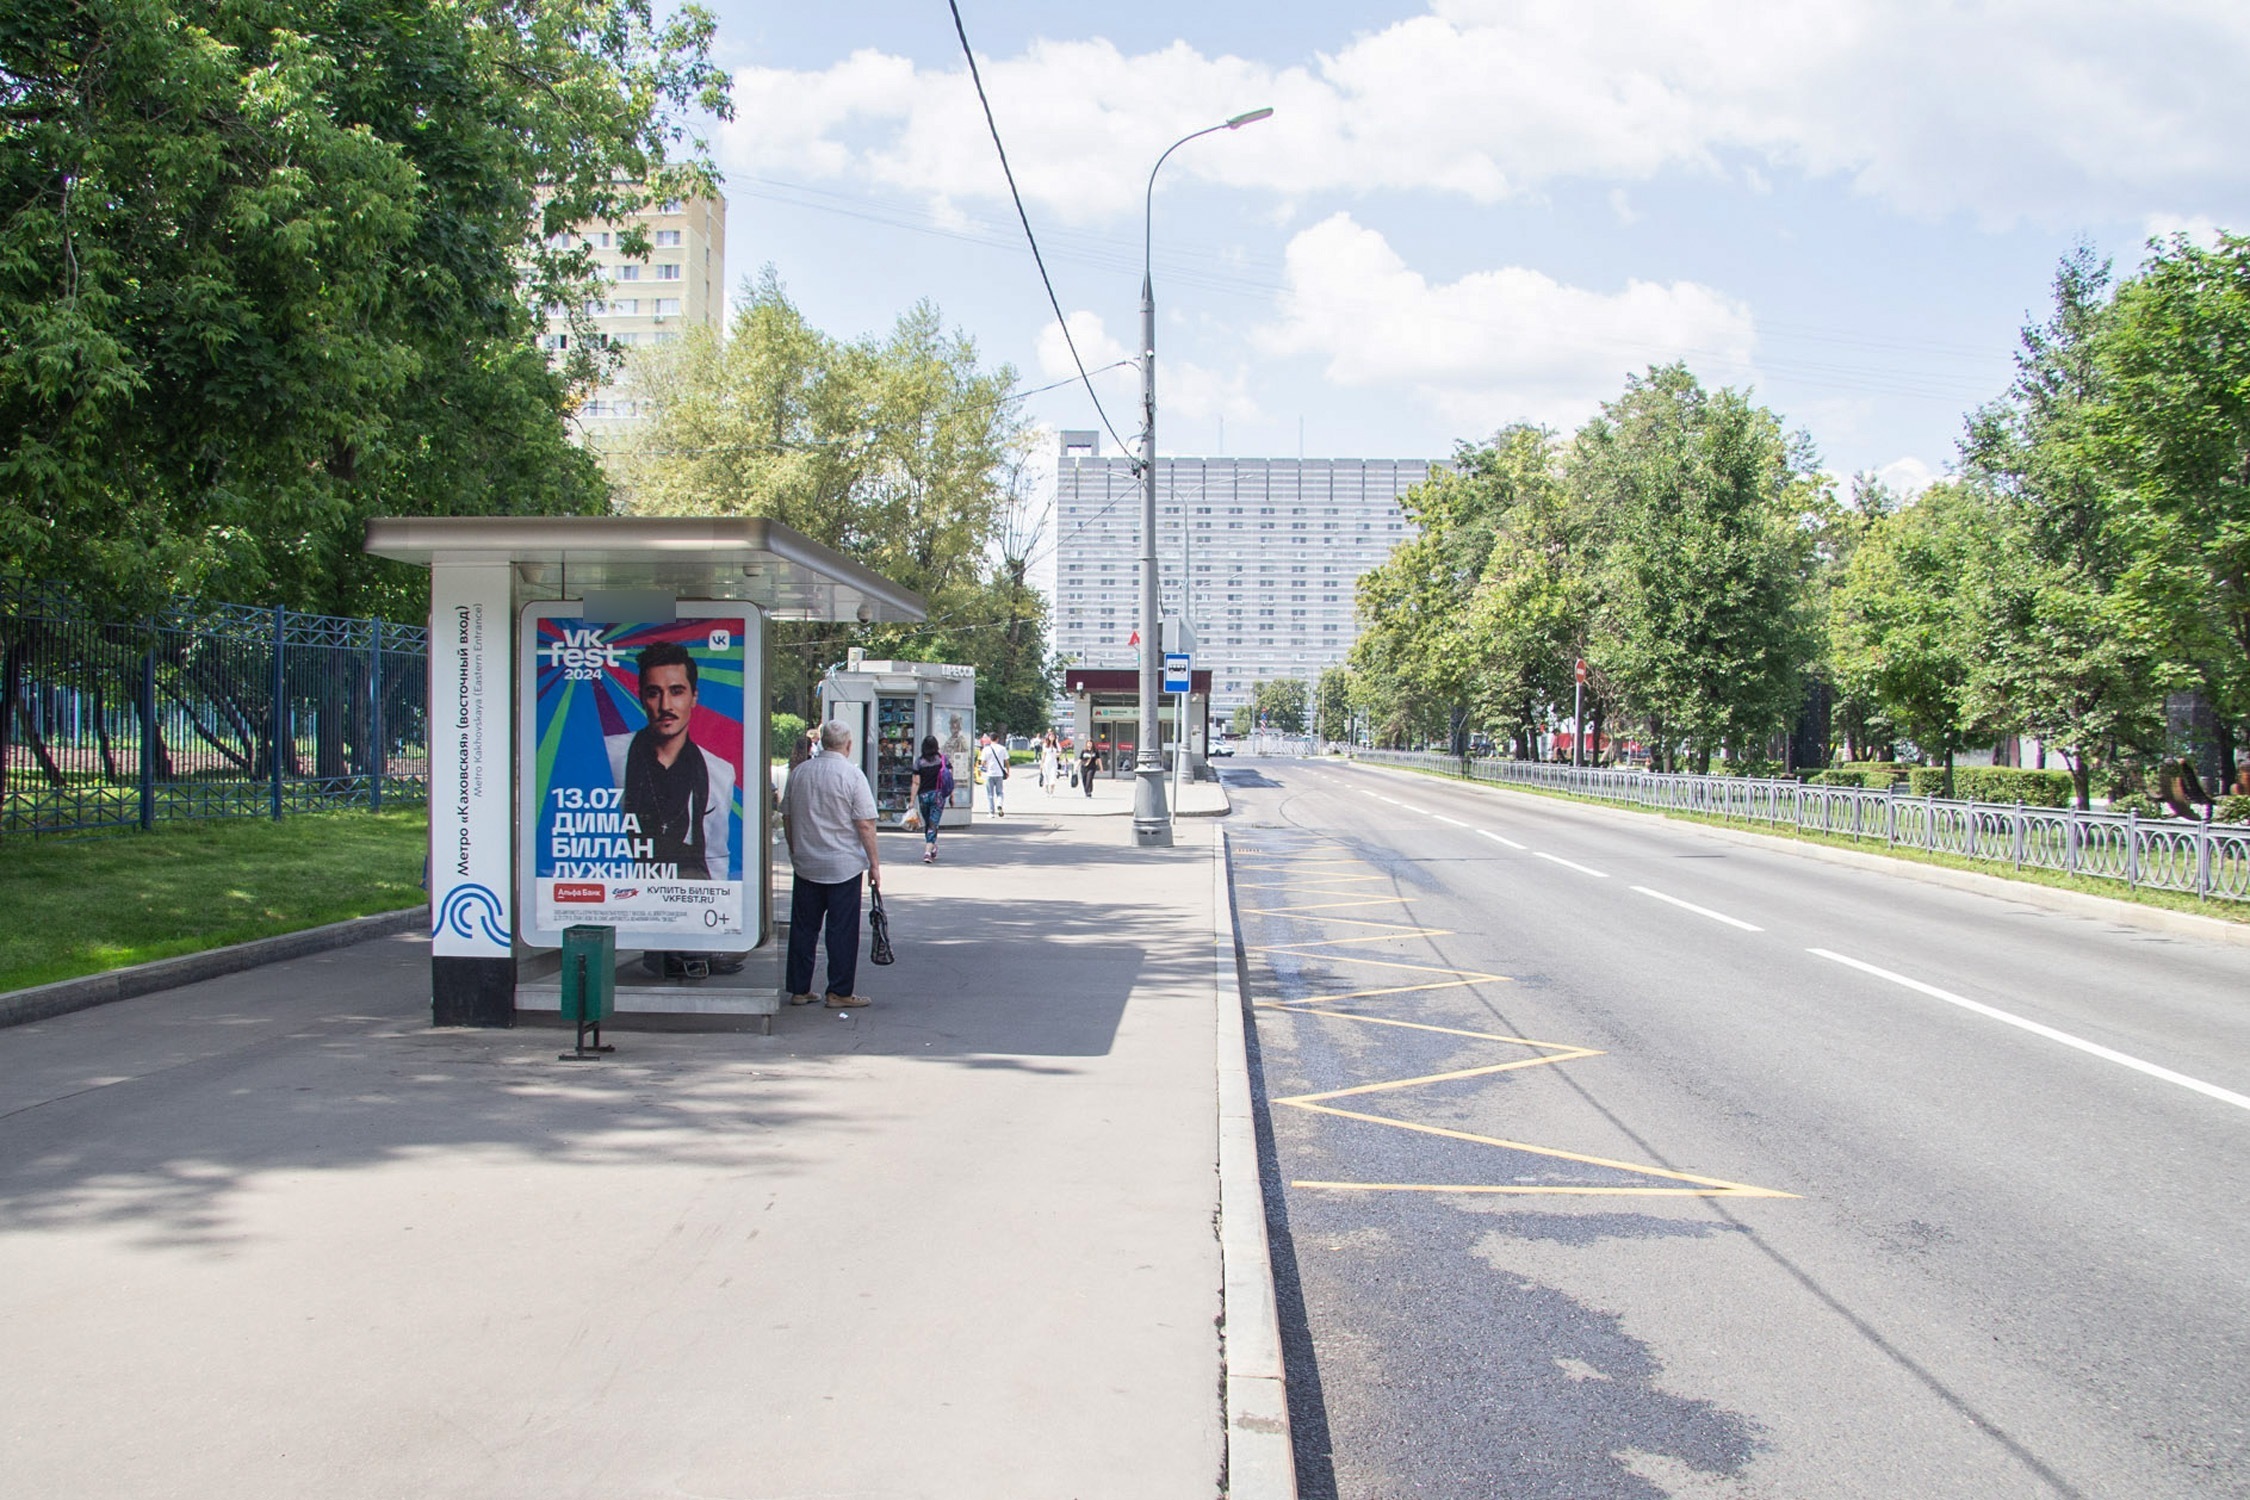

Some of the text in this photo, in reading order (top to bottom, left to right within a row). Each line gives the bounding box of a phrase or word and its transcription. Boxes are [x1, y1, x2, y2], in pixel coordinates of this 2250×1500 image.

[563, 629, 605, 648] VK
[712, 637, 726, 645] VK
[538, 642, 626, 668] fest
[564, 669, 602, 680] 2024
[941, 664, 974, 677] ПРЕССА
[473, 603, 483, 797] Metro Kakhovskaya (Eastern Entrance)
[455, 605, 471, 876] Метро «Каховская» (восточный вход)
[551, 788, 624, 809] 13.07
[552, 813, 642, 836] ДИМА
[552, 837, 654, 859] БИЛАН
[553, 862, 677, 880] ЛУЖНИКИ
[582, 888, 601, 897] Банк
[647, 886, 731, 897] КУПИТЬ БИЛЕТЫ
[662, 895, 715, 904] VKFEST.RU
[704, 909, 730, 928] 0+
